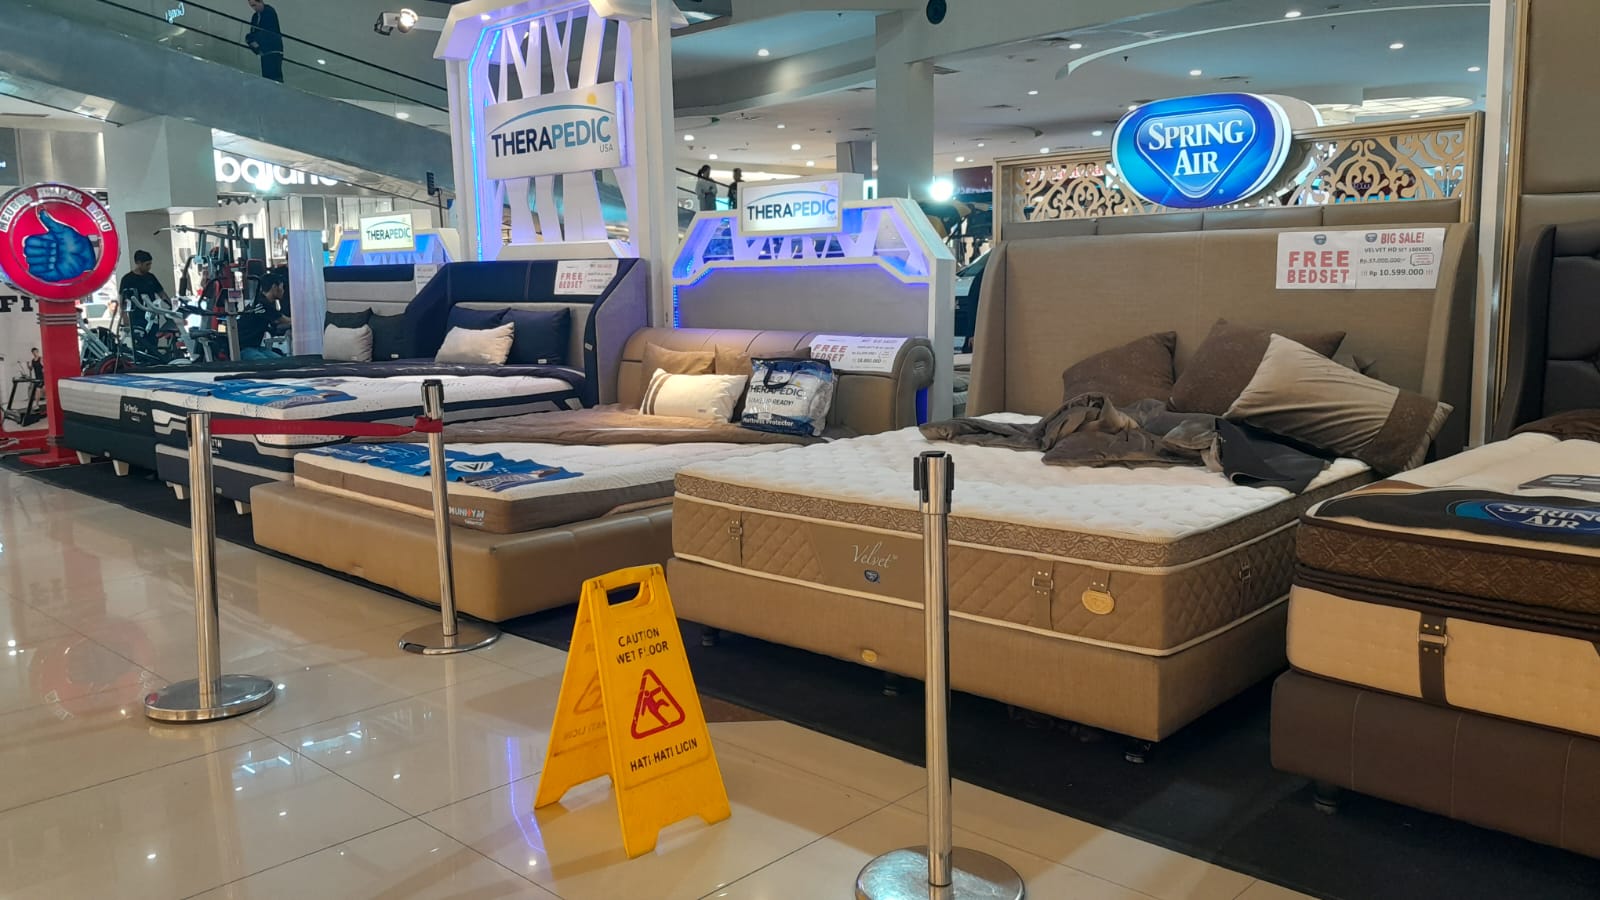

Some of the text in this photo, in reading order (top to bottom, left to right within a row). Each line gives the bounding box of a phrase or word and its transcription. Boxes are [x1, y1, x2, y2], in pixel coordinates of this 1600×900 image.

[491, 115, 611, 158] THERAPEDIC
[1149, 120, 1244, 150] SPRING
[600, 144, 614, 153] USA
[1173, 150, 1219, 177] AIR
[746, 199, 836, 221] THERAPEDIC
[366, 227, 412, 241] THERAPEDIC
[1381, 232, 1424, 244] BIG SALE!
[1288, 250, 1349, 268] FREE
[560, 272, 583, 281] FREE
[1287, 269, 1349, 284] BEDSET
[813, 344, 848, 353] FREE
[766, 418, 794, 427] Protector
[1521, 515, 1580, 530] AIR
[851, 541, 892, 569] Velvet
[617, 627, 660, 648] CAUTION
[616, 650, 636, 665] WET
[675, 738, 698, 756] LICIN
